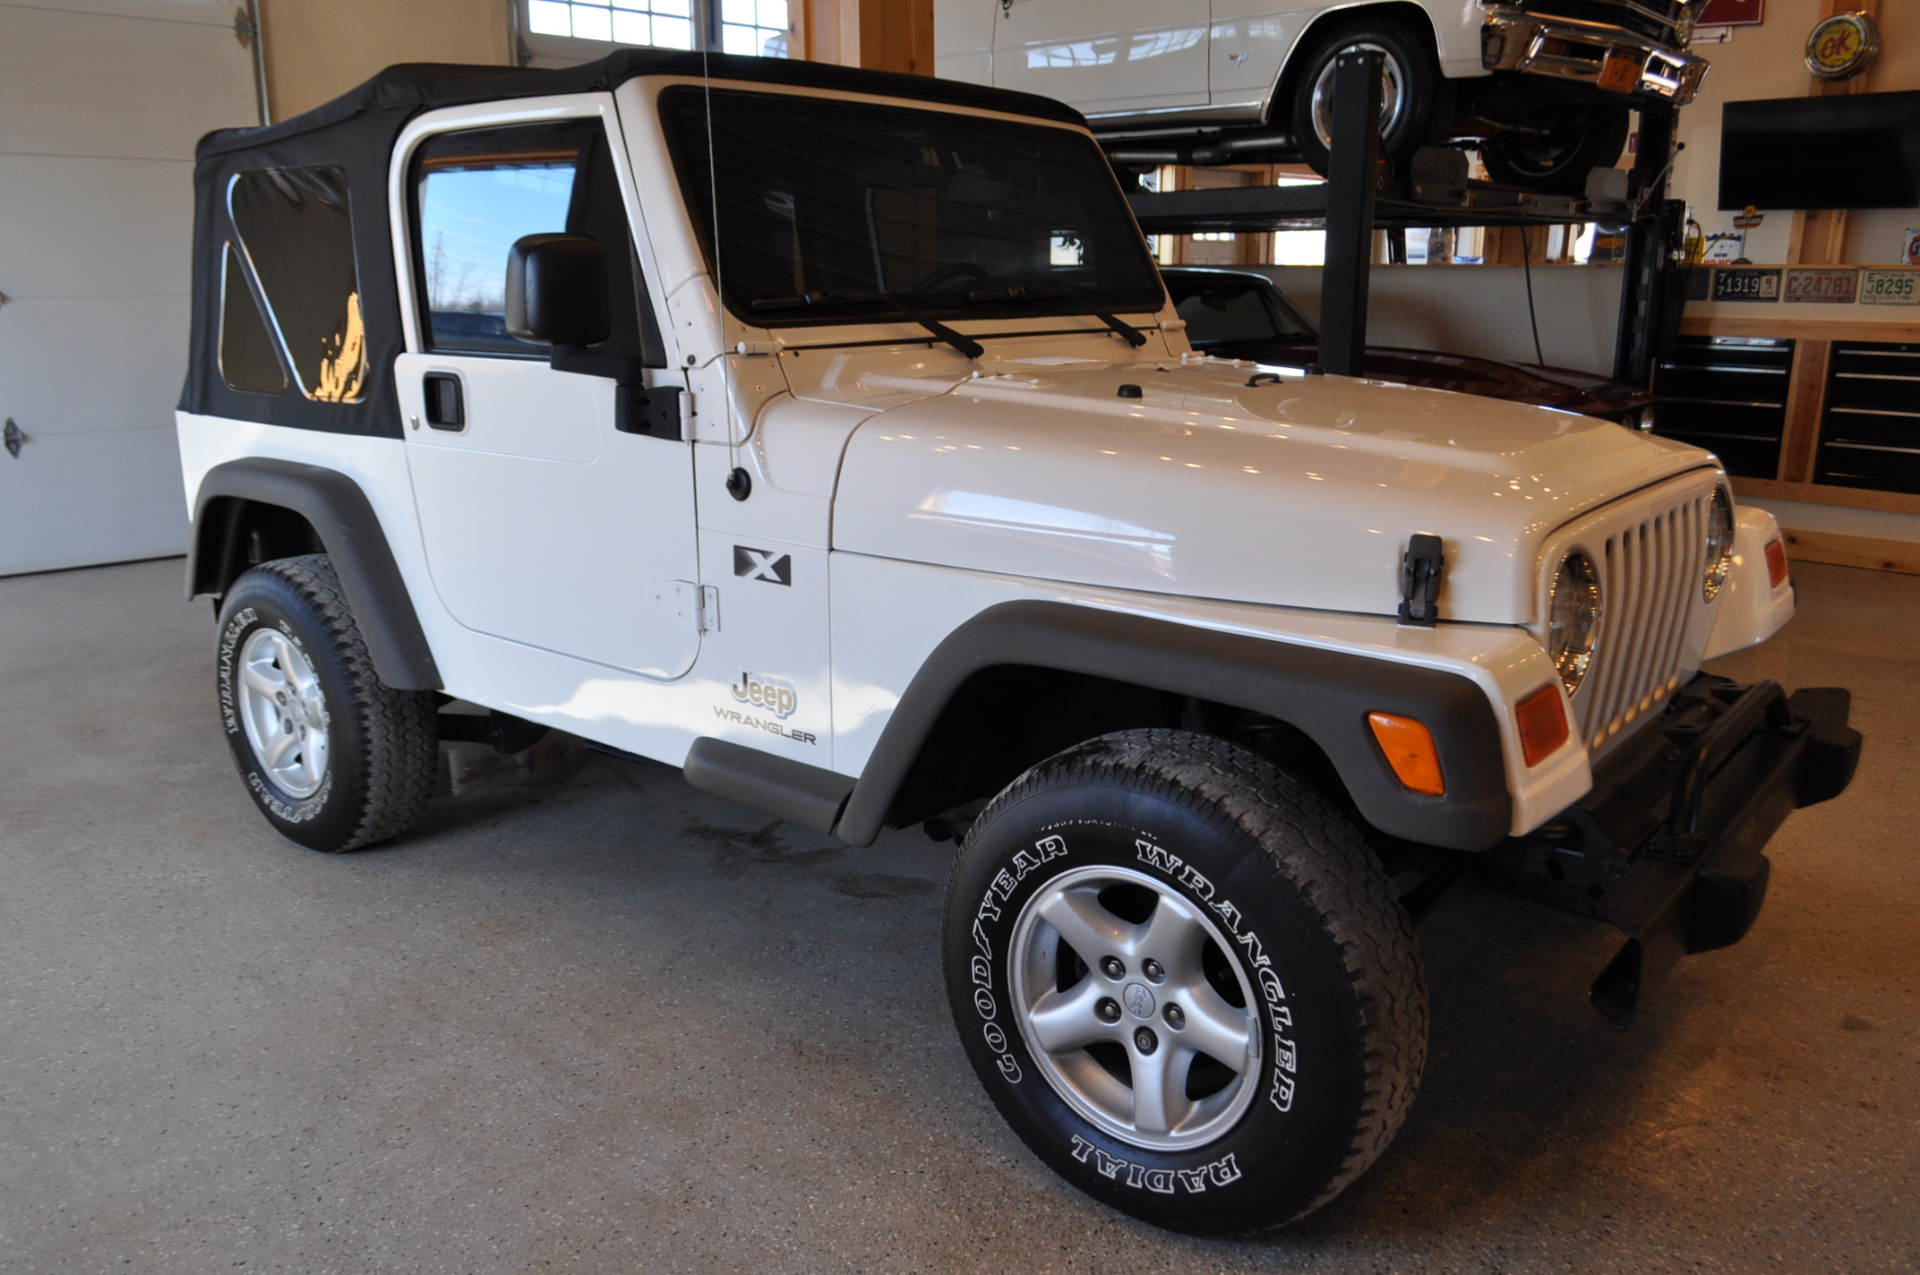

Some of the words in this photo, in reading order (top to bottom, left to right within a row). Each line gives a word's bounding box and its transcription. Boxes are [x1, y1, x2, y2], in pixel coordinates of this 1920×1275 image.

[1821, 27, 1854, 59] OK
[1726, 277, 1760, 293] 1319
[1875, 278, 1914, 295] 8295
[732, 671, 794, 715] Jeep
[713, 705, 817, 746] WRANGLER
[1135, 839, 1297, 1113] WRANGLER
[1071, 1133, 1242, 1195] RADIAL
